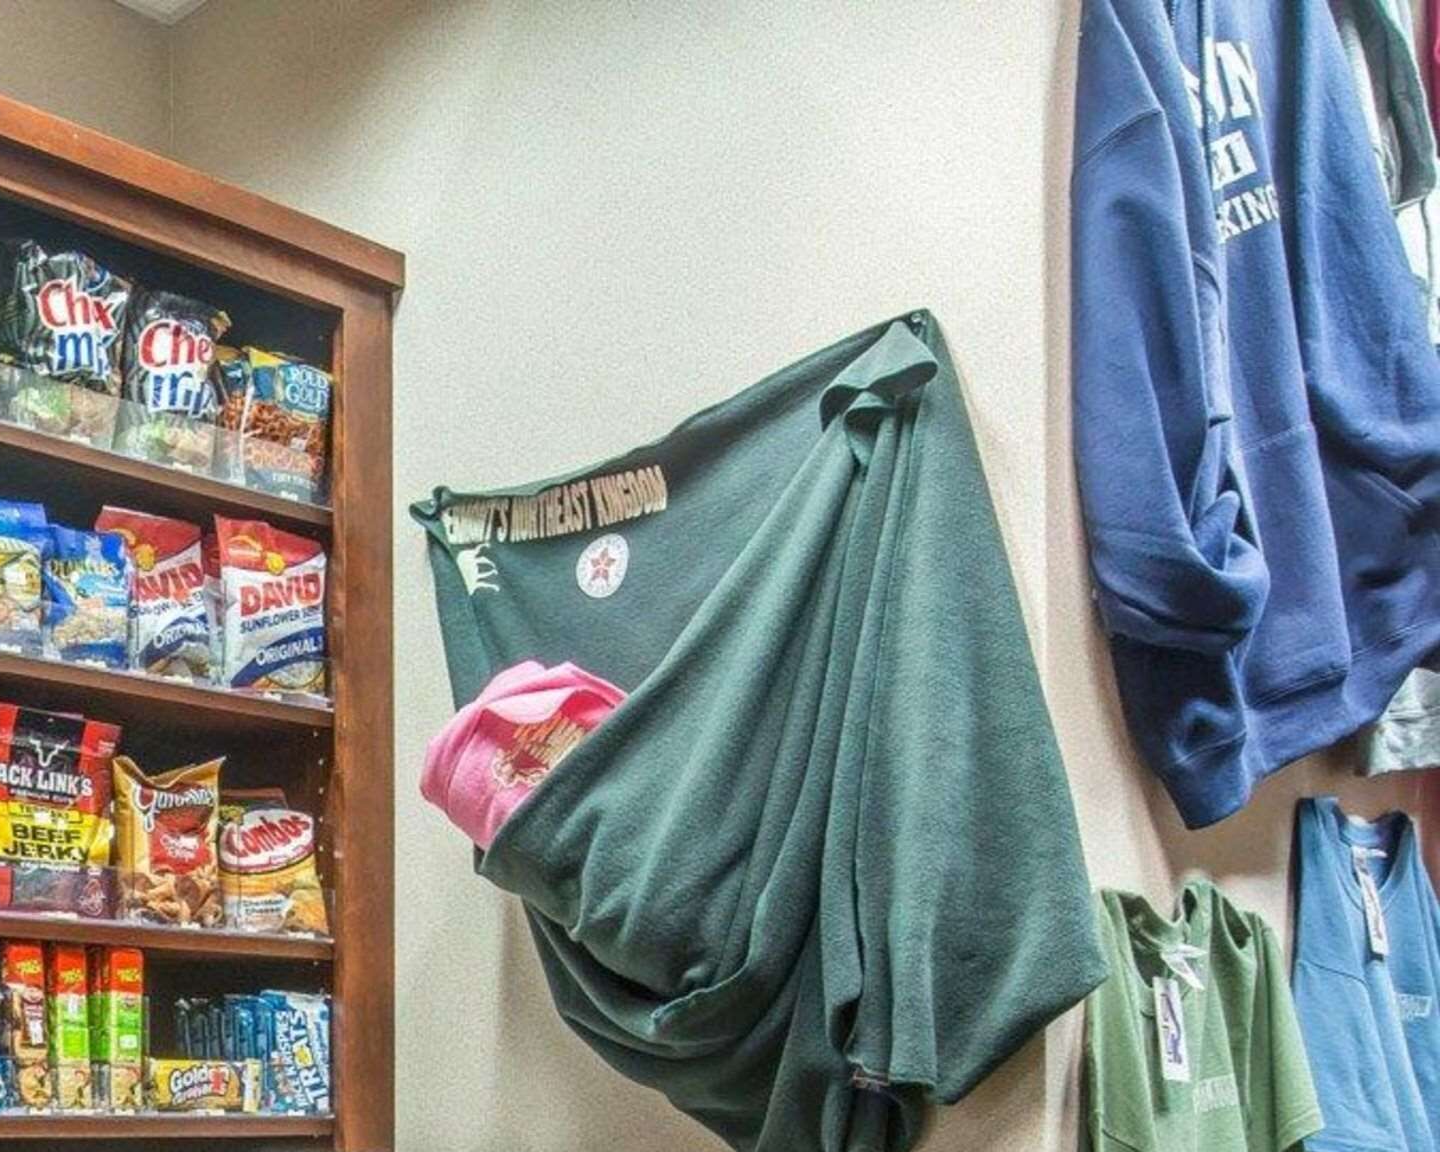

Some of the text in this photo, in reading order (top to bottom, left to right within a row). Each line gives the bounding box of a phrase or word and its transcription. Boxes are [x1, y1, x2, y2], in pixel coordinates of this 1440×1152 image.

[36, 278, 118, 331] Chx
[139, 318, 214, 369] Che
[589, 464, 668, 528] KINGDOM
[134, 560, 205, 603] AVID
[240, 572, 322, 617] DAVID
[255, 637, 317, 667] ORIGINAL
[36, 770, 94, 797] LINK'S
[3, 840, 89, 865] JERKY
[11, 822, 82, 845] BEEF
[225, 814, 311, 859] Combos
[170, 1063, 230, 1095] Goldn
[290, 1010, 328, 1104] TRATS
